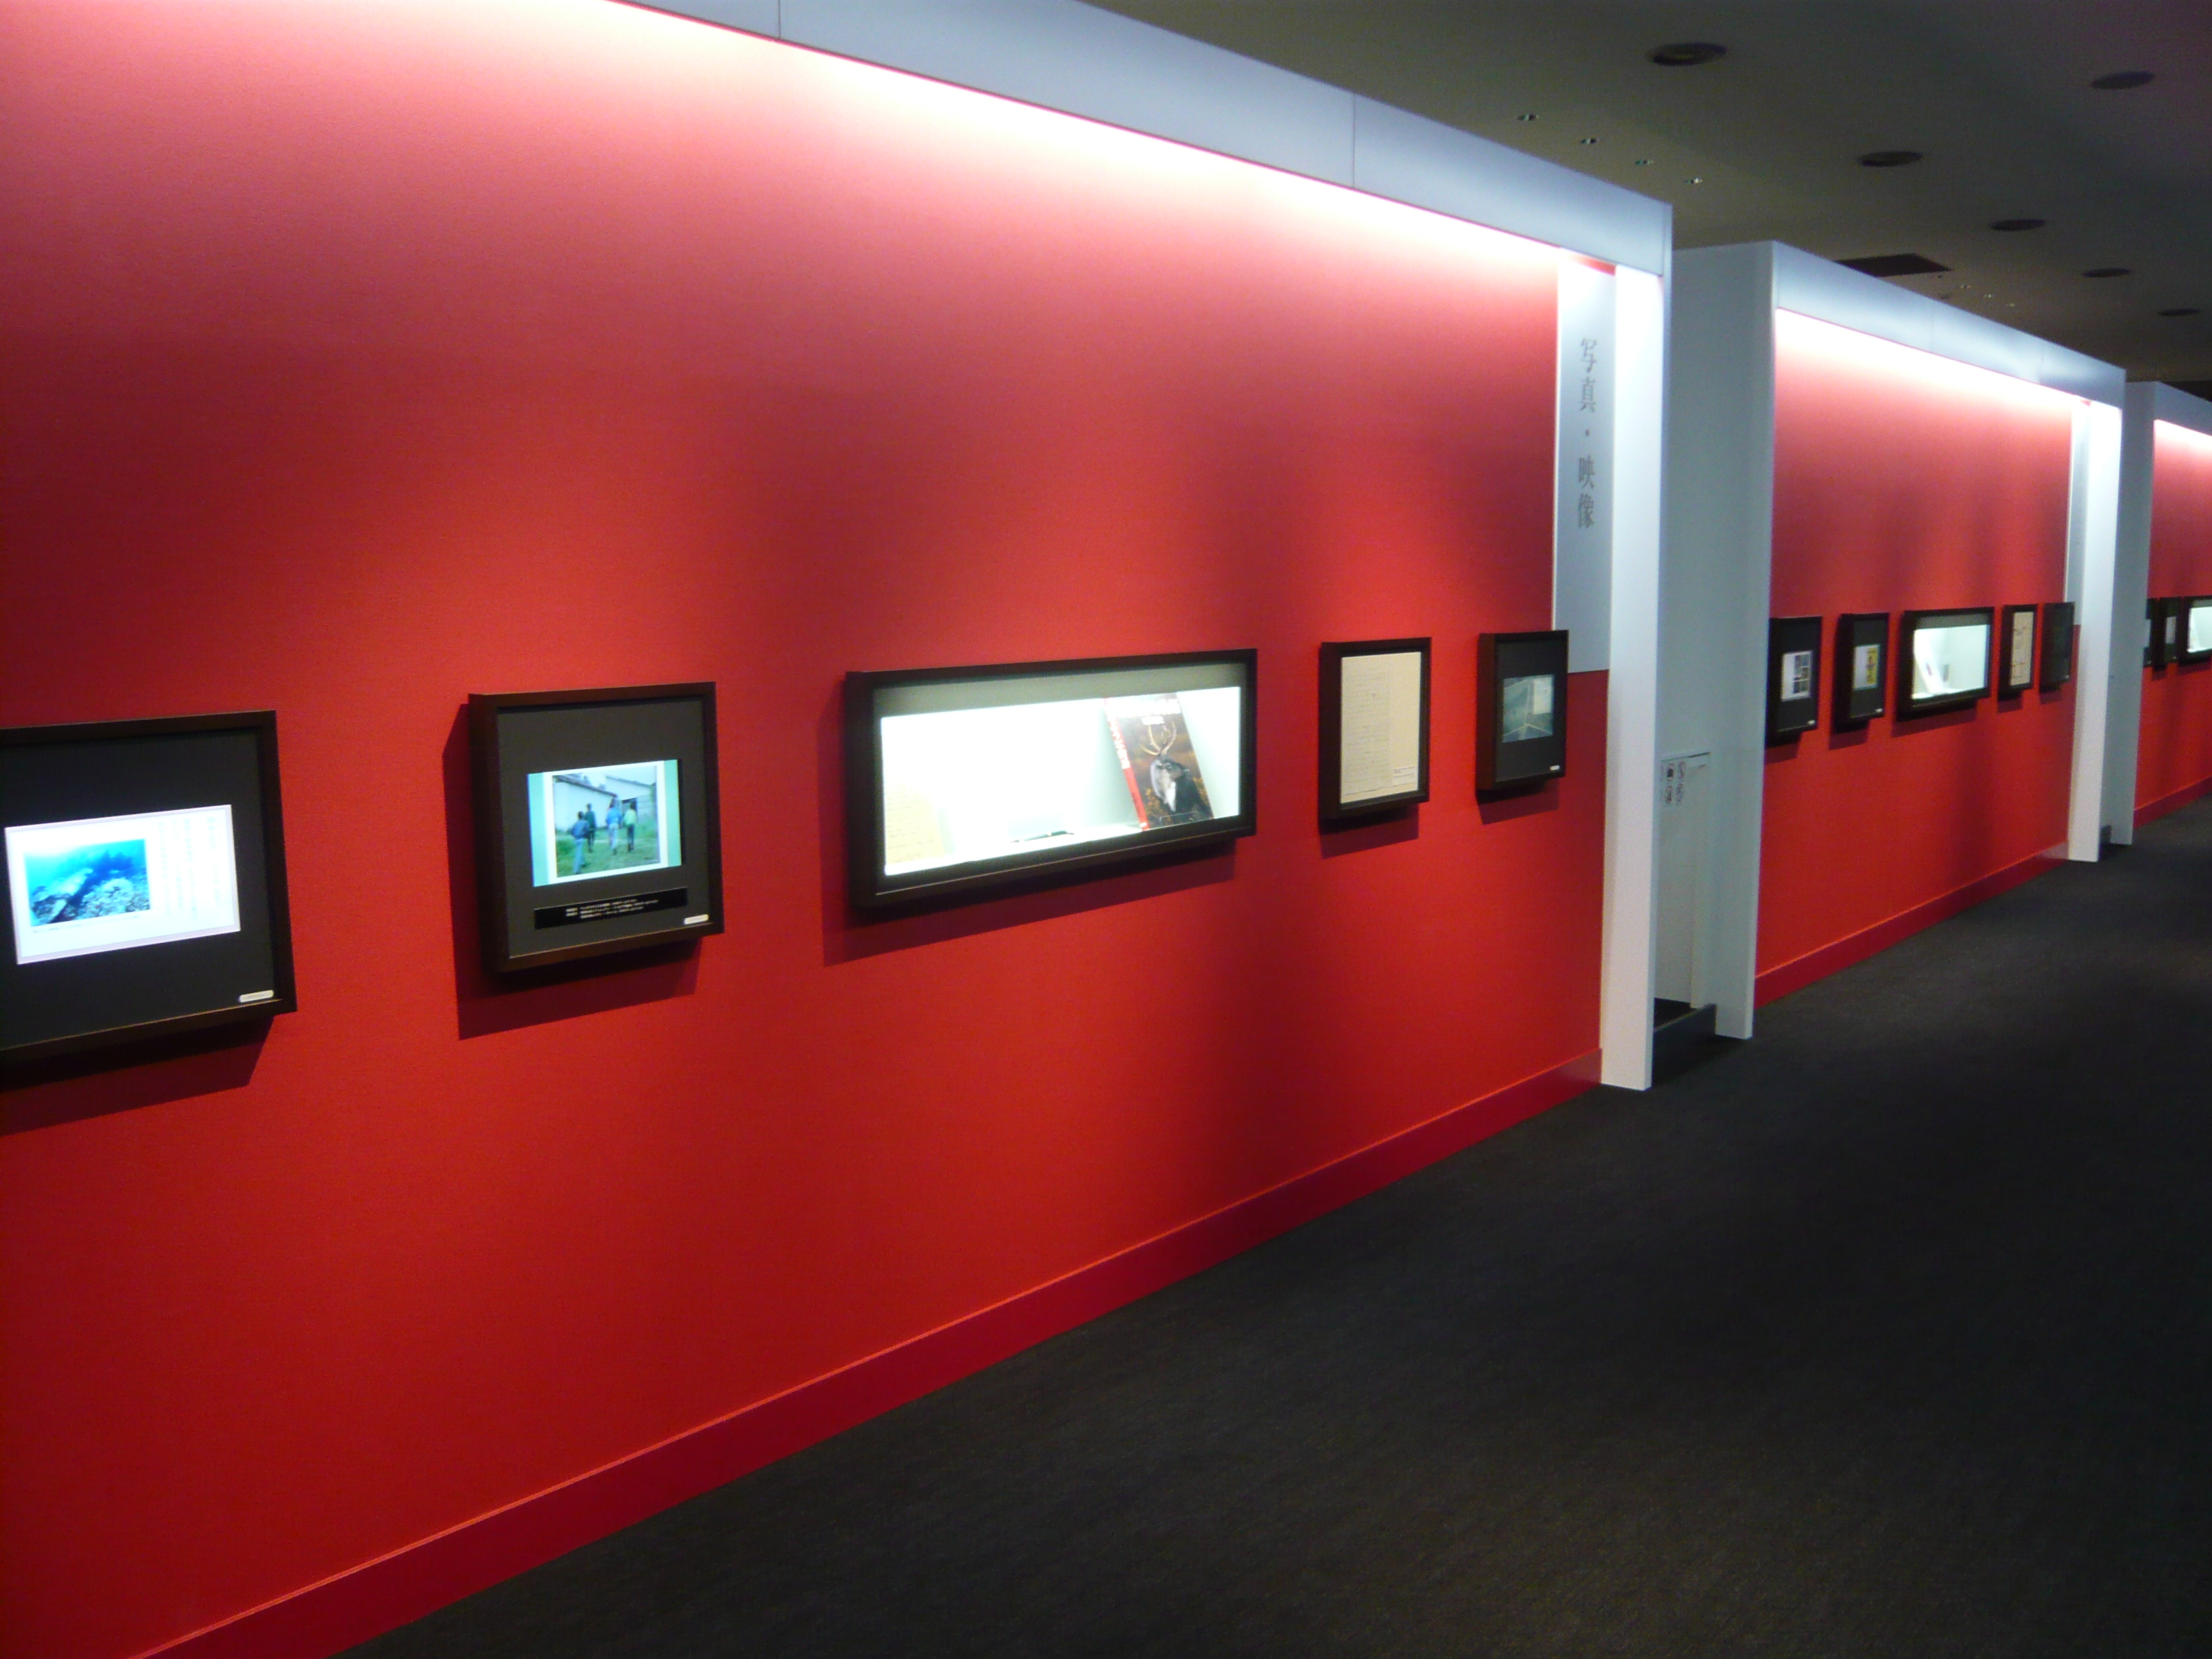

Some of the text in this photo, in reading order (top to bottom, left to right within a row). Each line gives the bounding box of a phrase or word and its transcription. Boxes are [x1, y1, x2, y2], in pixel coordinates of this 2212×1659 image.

[1578, 338, 1597, 529] 写真・映像
